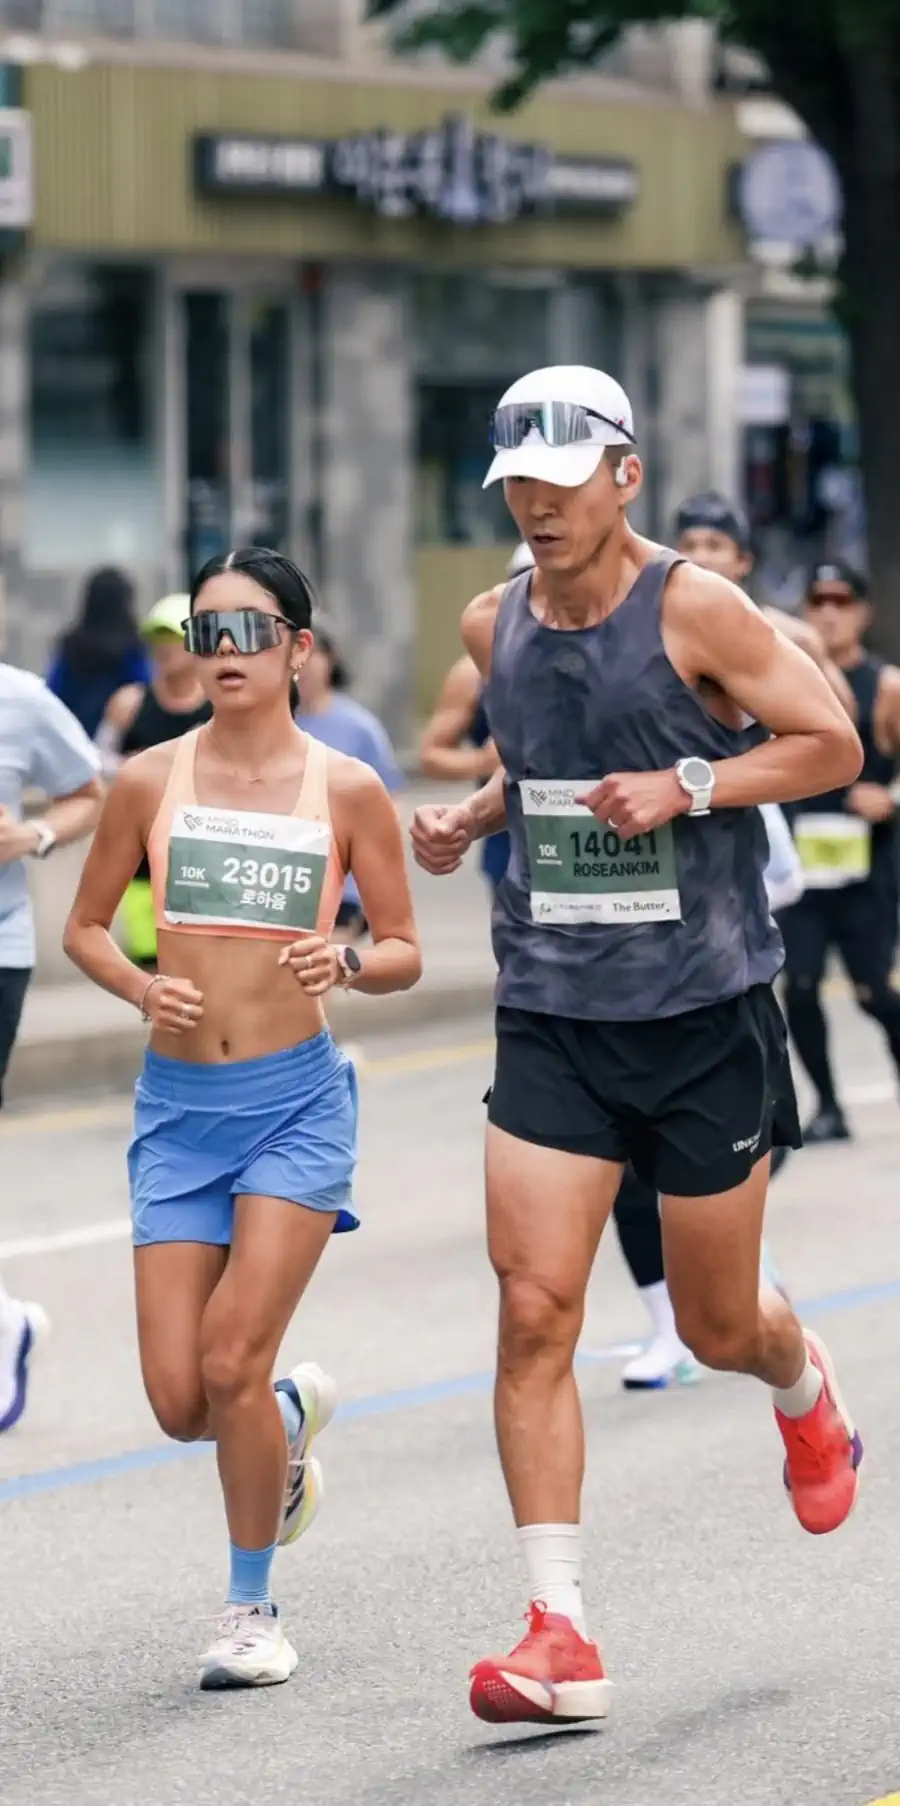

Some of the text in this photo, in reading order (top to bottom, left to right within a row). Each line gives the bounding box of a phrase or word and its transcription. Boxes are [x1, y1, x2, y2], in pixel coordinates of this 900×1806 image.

[206, 824, 275, 841] MARATHON
[538, 844, 558, 857] 10K
[570, 830, 657, 858] 14041
[180, 865, 206, 881] 10K
[221, 857, 312, 894] 23015
[574, 860, 660, 878] ROSEANKIM
[239, 888, 288, 912] 로하음
[612, 903, 632, 912] The
